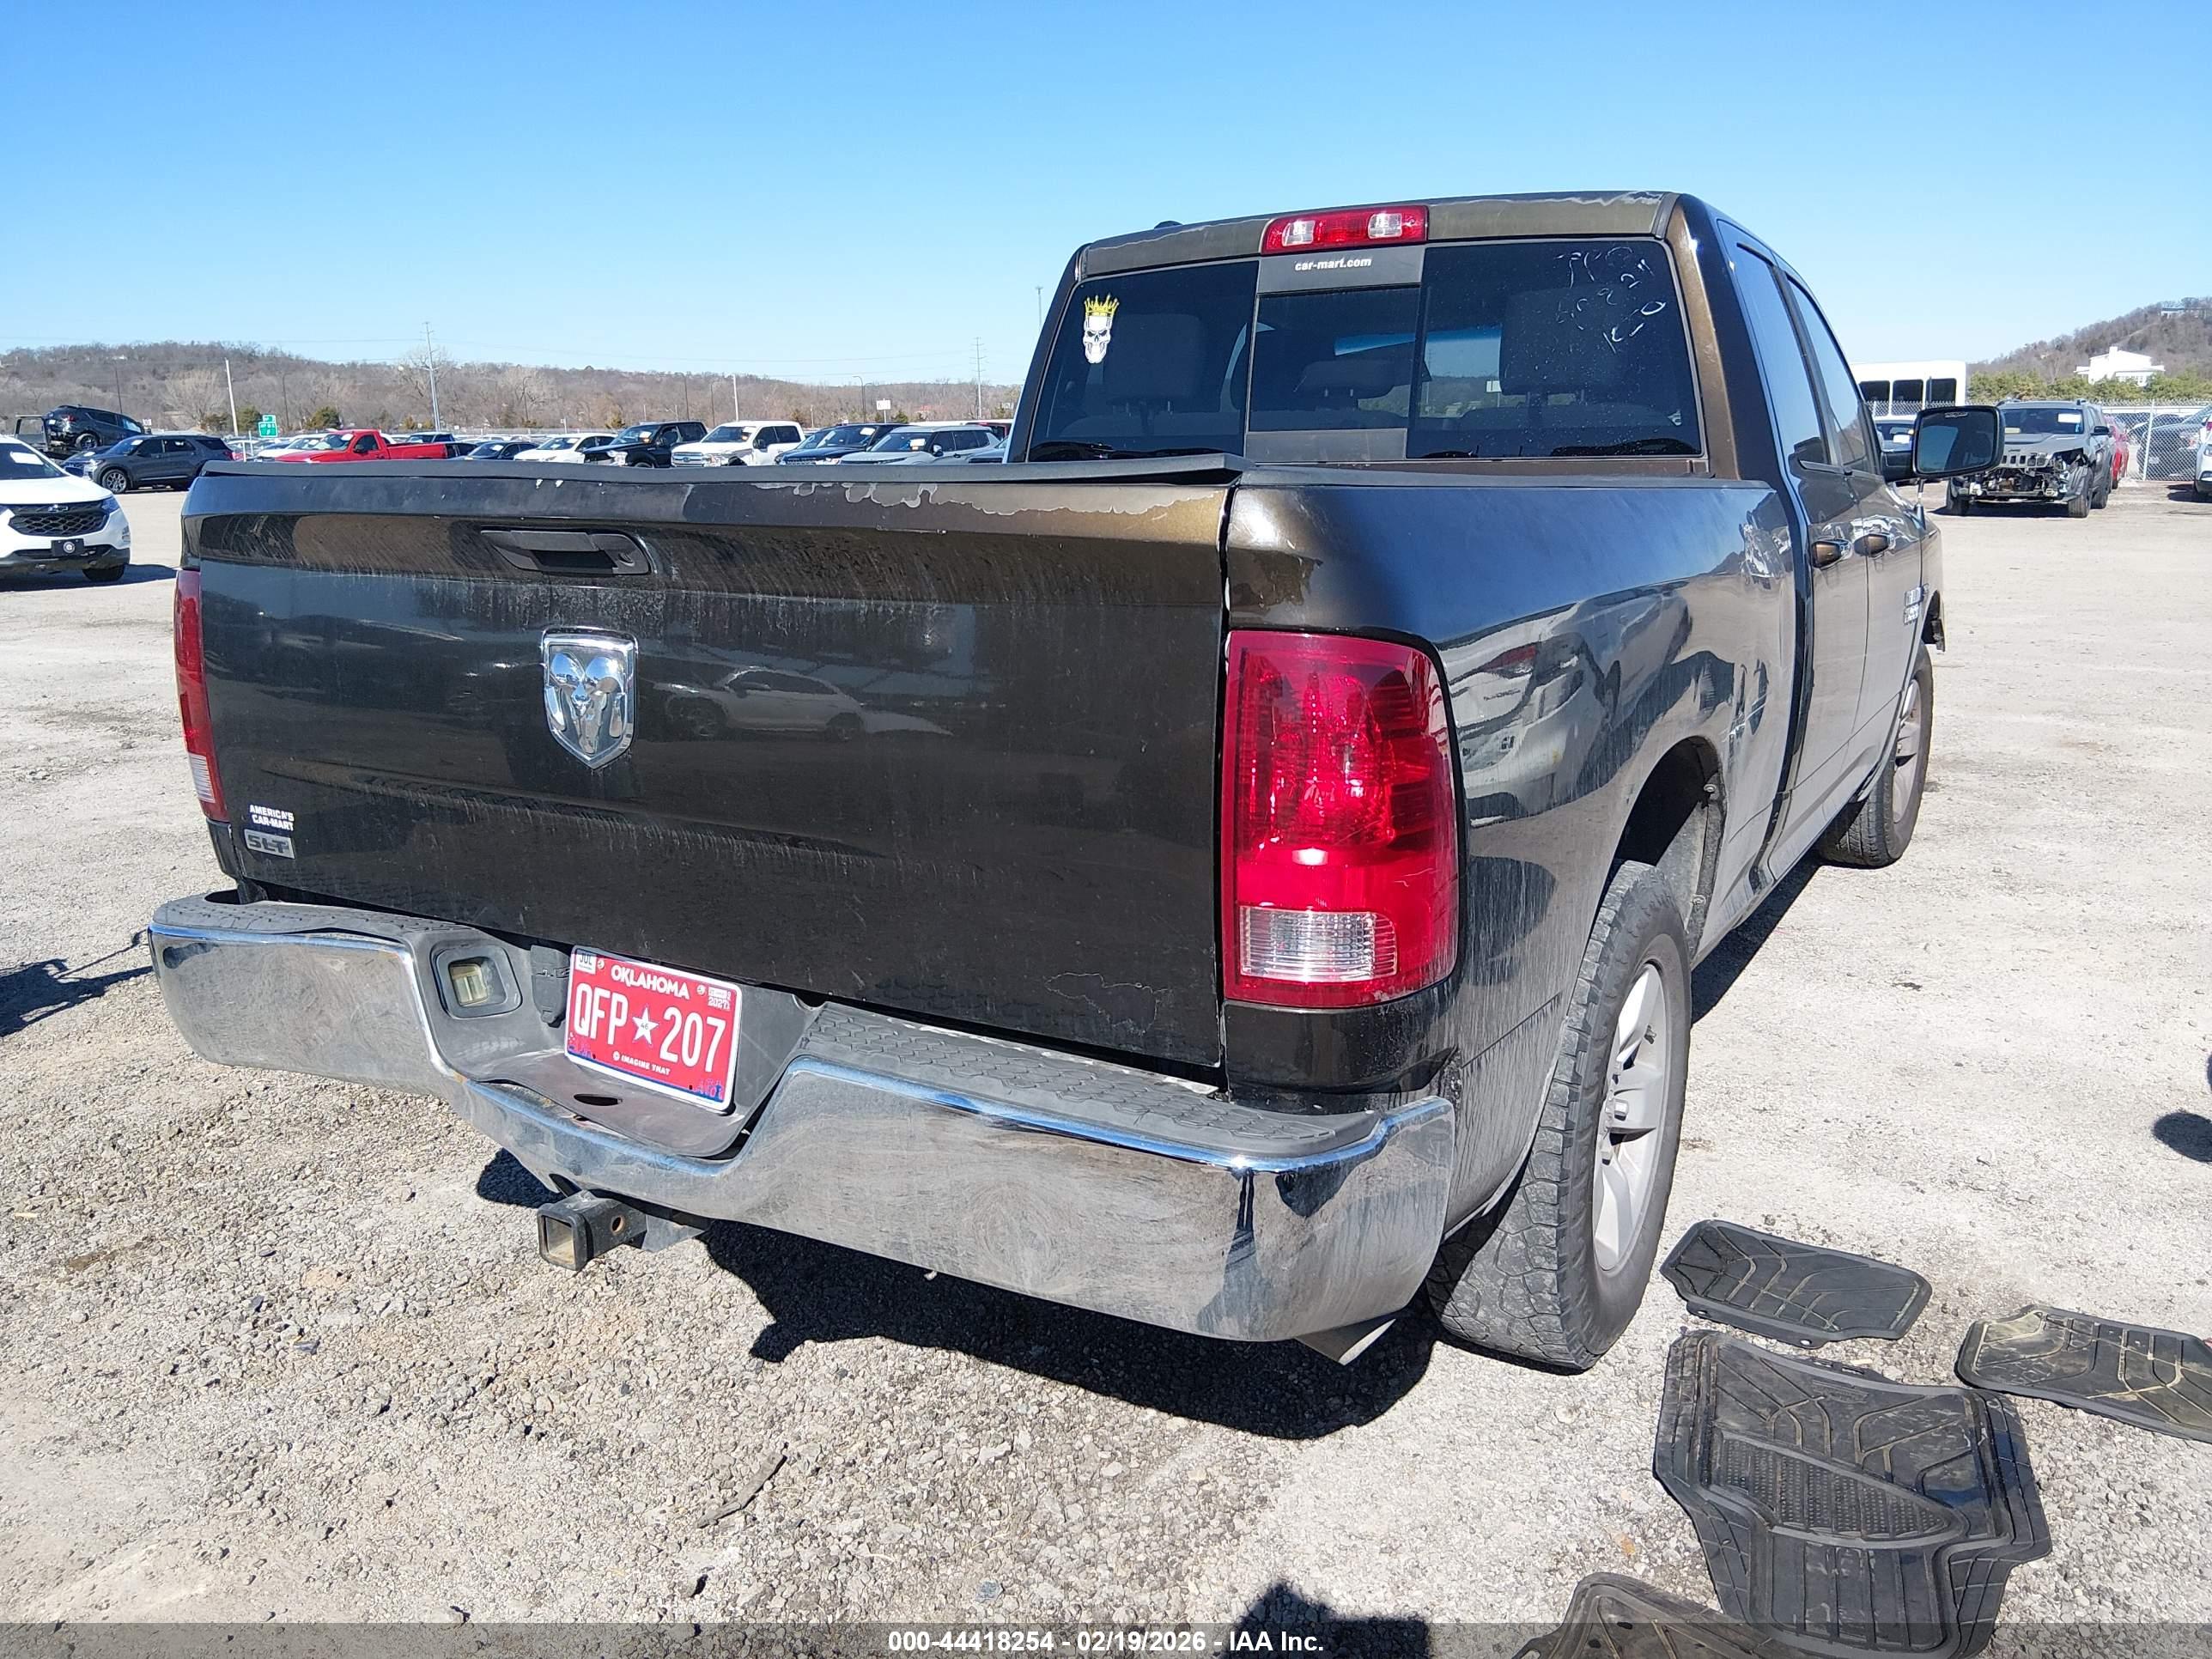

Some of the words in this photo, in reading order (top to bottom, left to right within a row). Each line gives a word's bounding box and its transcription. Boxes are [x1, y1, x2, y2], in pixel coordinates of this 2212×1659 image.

[1294, 258, 1372, 271] car-mart.com
[249, 804, 294, 822] AMERICA'S
[252, 814, 294, 831] CAR-MART
[247, 834, 289, 854] SLT
[611, 964, 690, 1000] OKLAHOMA
[574, 982, 629, 1045] QFP
[659, 1006, 726, 1073] 207
[621, 1054, 650, 1070] IMAGINE
[652, 1063, 670, 1076] THAT
